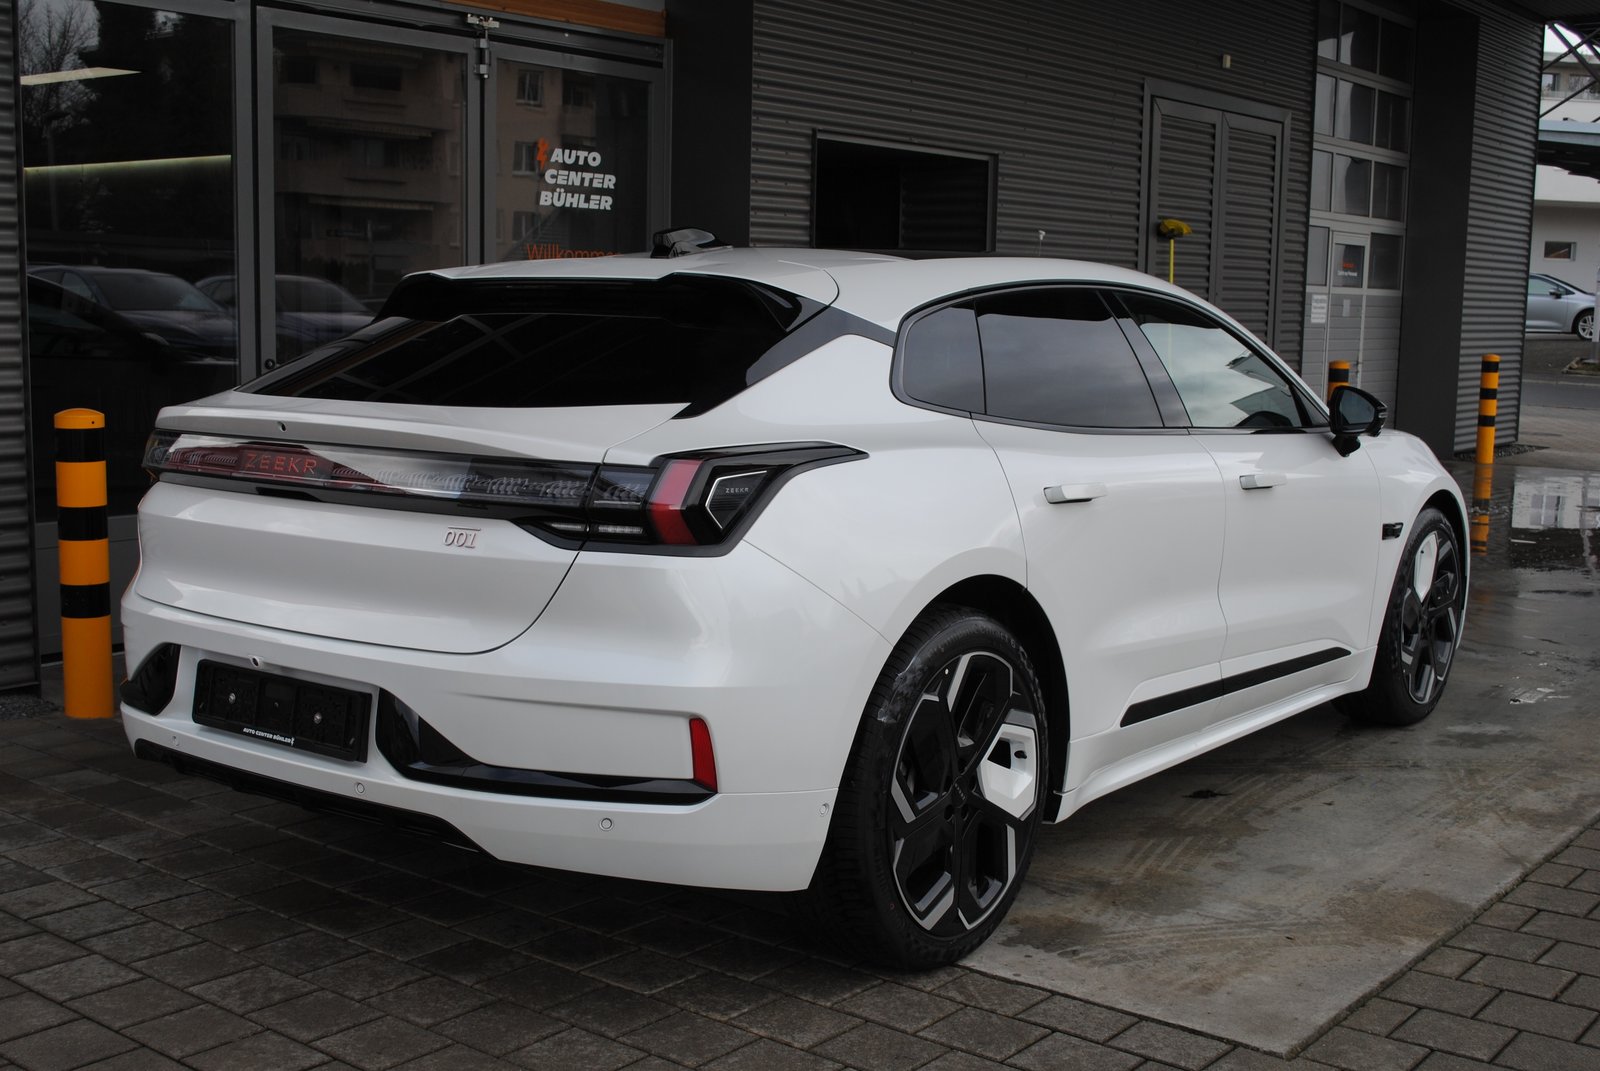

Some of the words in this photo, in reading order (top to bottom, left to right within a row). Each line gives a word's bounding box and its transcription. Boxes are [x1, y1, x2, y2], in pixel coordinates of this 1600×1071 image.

[550, 148, 602, 167] AUTO
[544, 169, 617, 189] CENTER
[539, 188, 613, 210] BÜHLER
[527, 243, 622, 260] Willkomm
[245, 452, 317, 474] ZEEKR
[443, 529, 478, 549] 001
[256, 730, 273, 738] CENTER
